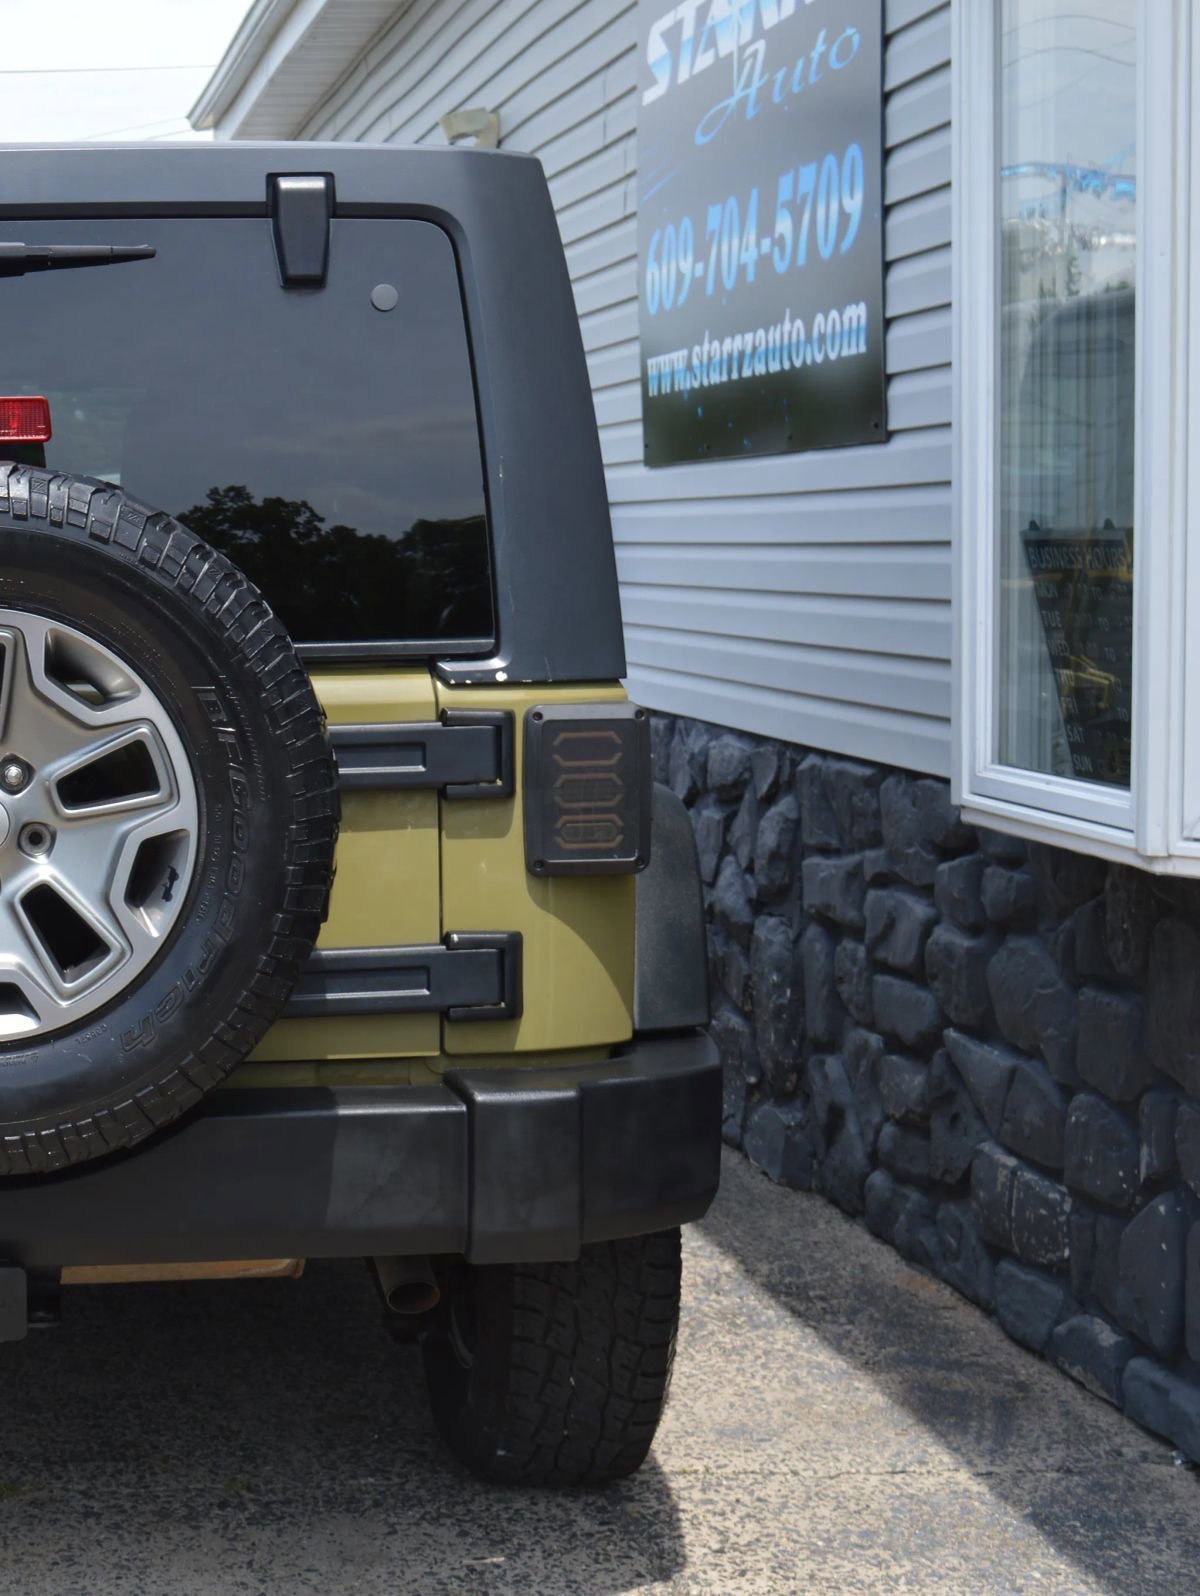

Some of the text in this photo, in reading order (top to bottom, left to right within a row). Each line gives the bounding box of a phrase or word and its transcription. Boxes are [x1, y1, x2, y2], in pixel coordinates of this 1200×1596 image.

[694, 26, 861, 145] Auto
[646, 143, 864, 315] 609-704-5709
[647, 301, 867, 396] www.starrzauto.com
[1029, 547, 1127, 569] BUSINESS HOURS
[1041, 610, 1062, 628] TUE
[1067, 725, 1086, 744] SAT
